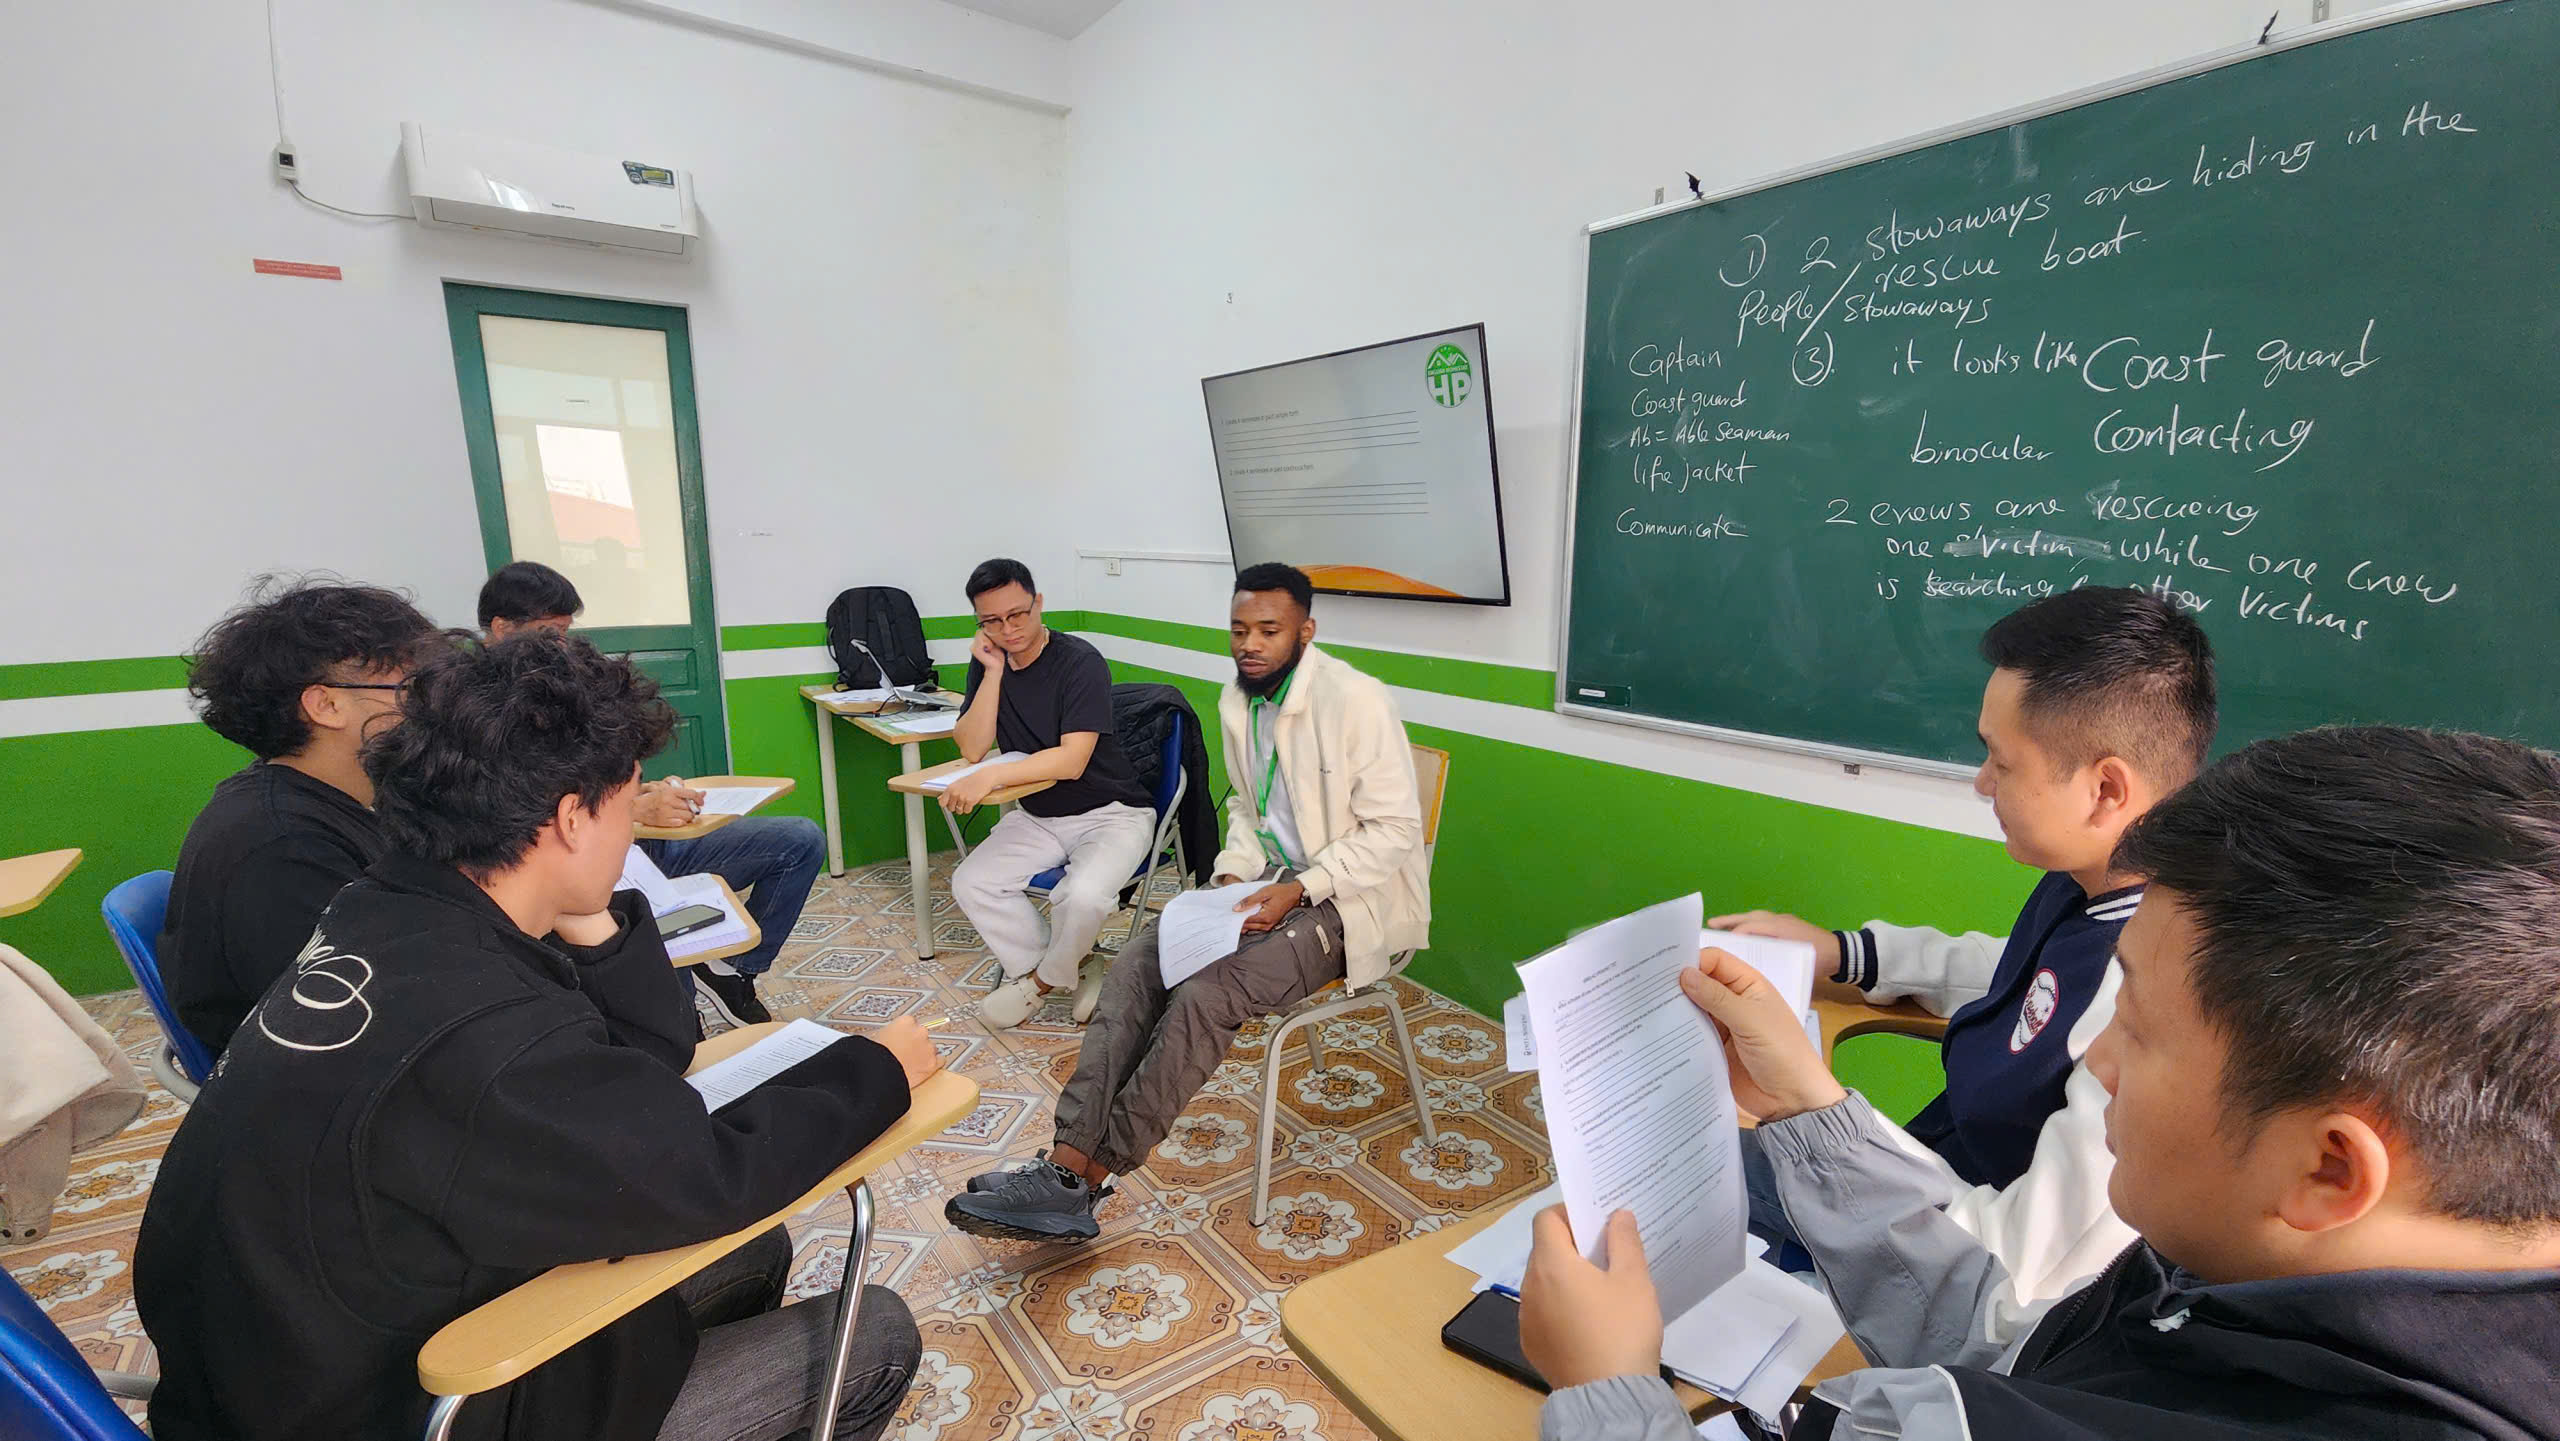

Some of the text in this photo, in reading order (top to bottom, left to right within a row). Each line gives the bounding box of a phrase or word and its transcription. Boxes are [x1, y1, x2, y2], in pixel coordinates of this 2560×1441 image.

[1800, 236, 1837, 274] 2
[2193, 136, 2316, 187] hiding
[2348, 124, 2377, 146] in
[2402, 101, 2478, 137] the
[1875, 256, 2002, 293] rescue
[1629, 336, 1722, 385] Captain
[1894, 339, 1924, 376] it
[1953, 339, 2022, 374] looks
[2034, 331, 2079, 374] like
[2082, 328, 2226, 393] Coast
[2257, 319, 2384, 389] guard
[1631, 379, 1748, 418] Coast guard
[1675, 419, 1710, 446] Able
[1911, 409, 2054, 465] binocular
[1677, 450, 1759, 494] jacket
[1825, 498, 1859, 526] 2
[2097, 496, 2261, 536] rescueing
[1886, 536, 1935, 558] one
[2248, 552, 2320, 586] one
[1877, 572, 1900, 601] is
